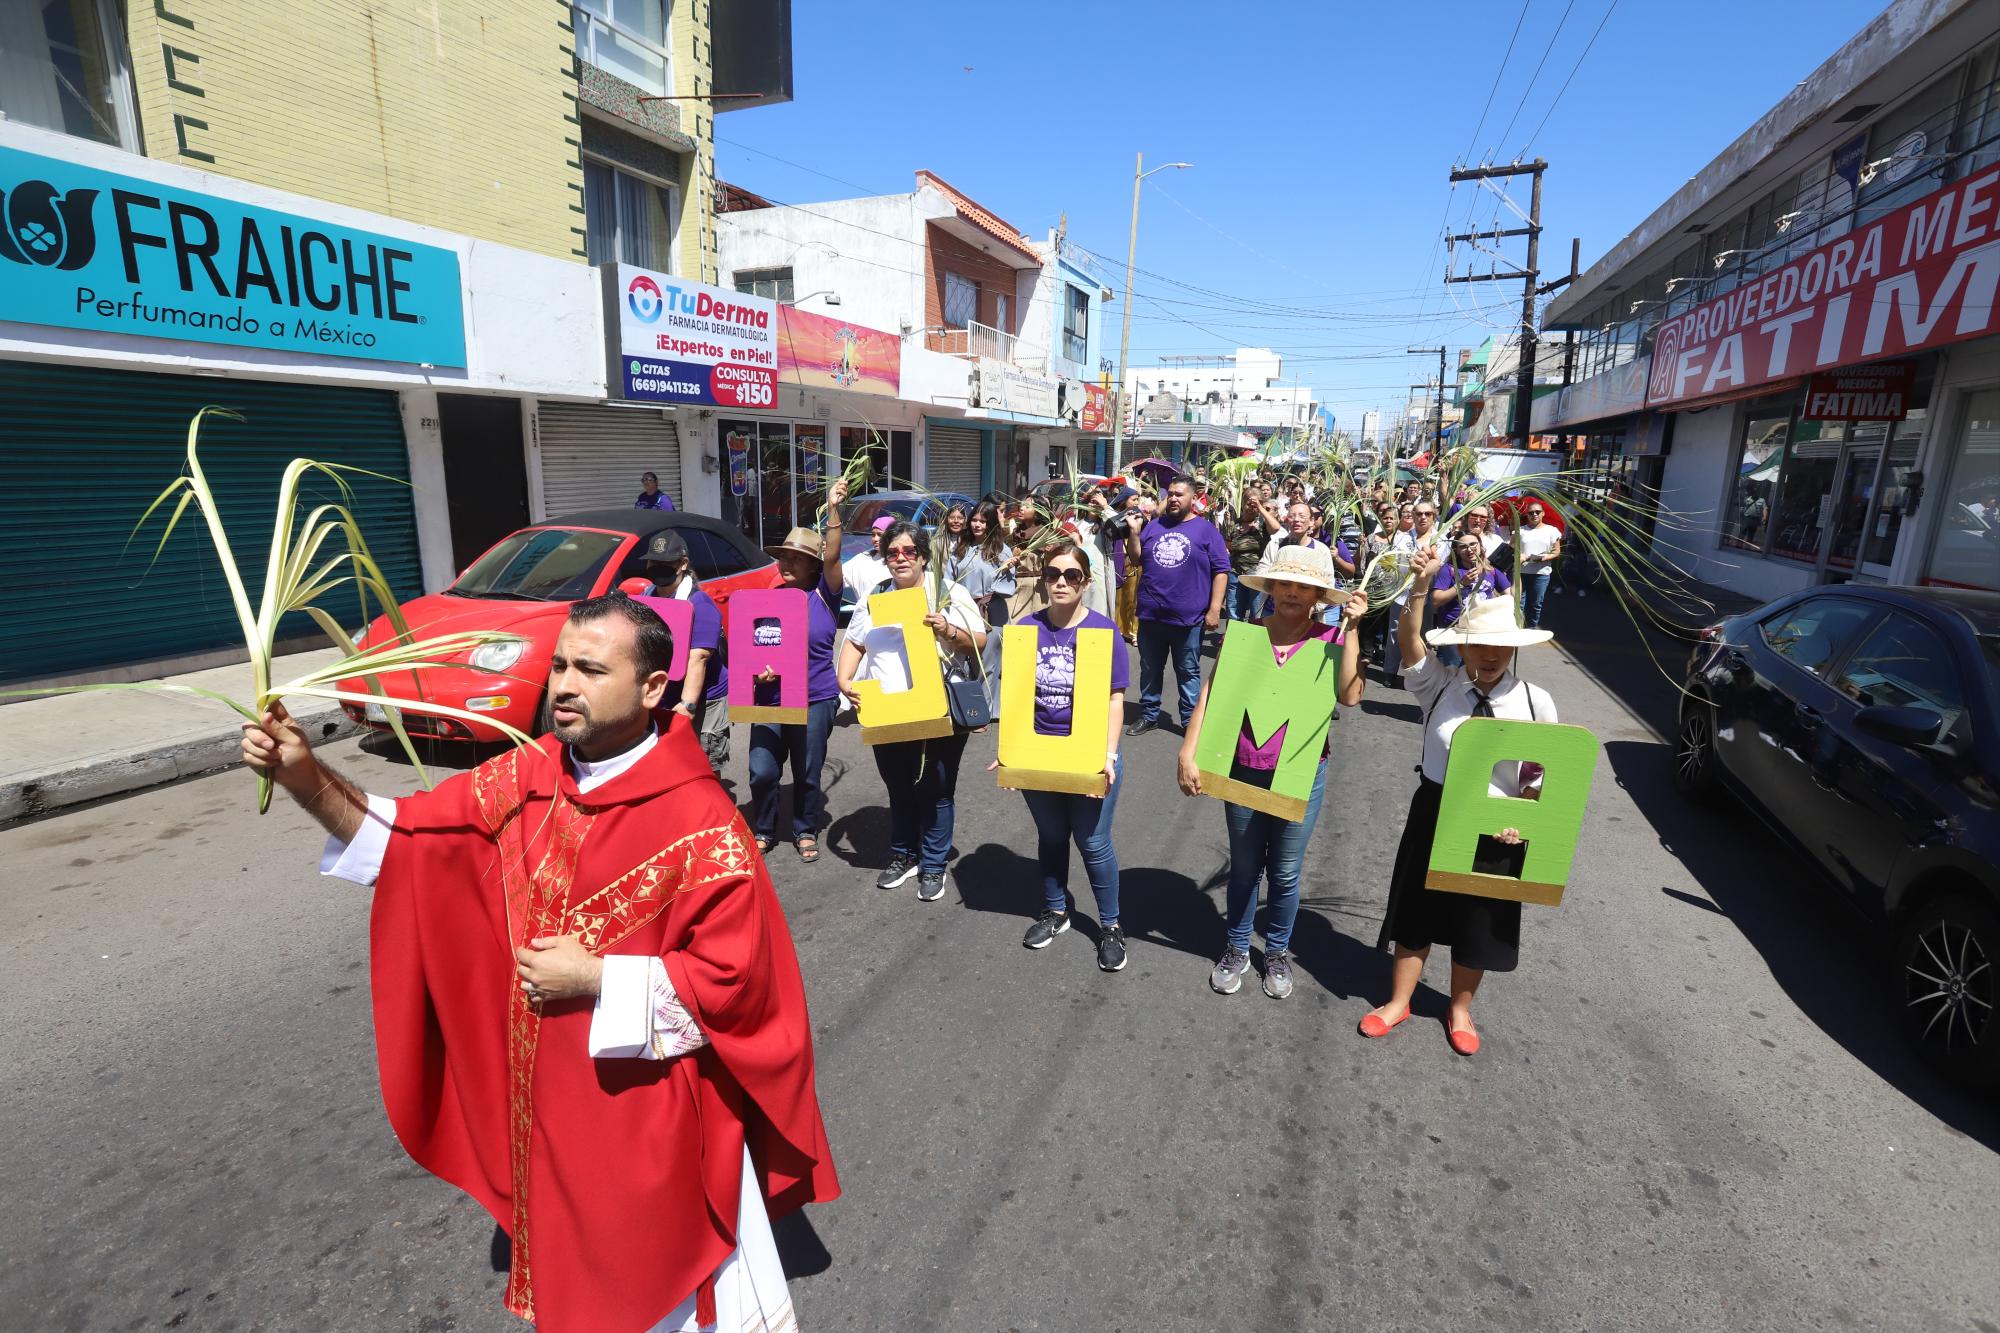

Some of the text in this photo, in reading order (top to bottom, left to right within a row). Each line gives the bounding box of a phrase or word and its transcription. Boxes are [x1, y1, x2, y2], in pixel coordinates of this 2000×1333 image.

[111, 188, 418, 324] FRAICHE
[1681, 170, 2000, 348] PROVEEDORA ME
[77, 287, 376, 347] Perfumando a México
[666, 285, 768, 329] TuDerma
[668, 315, 768, 342] FARMACIA DERMATOLÓGICA
[656, 334, 772, 364] ¡Expertos en Piel!
[643, 364, 670, 376] CITAS
[716, 367, 771, 384] CONSULTA
[632, 378, 700, 395] (669)9411326
[736, 383, 772, 405] $150
[1810, 393, 1902, 416] FATIMA
